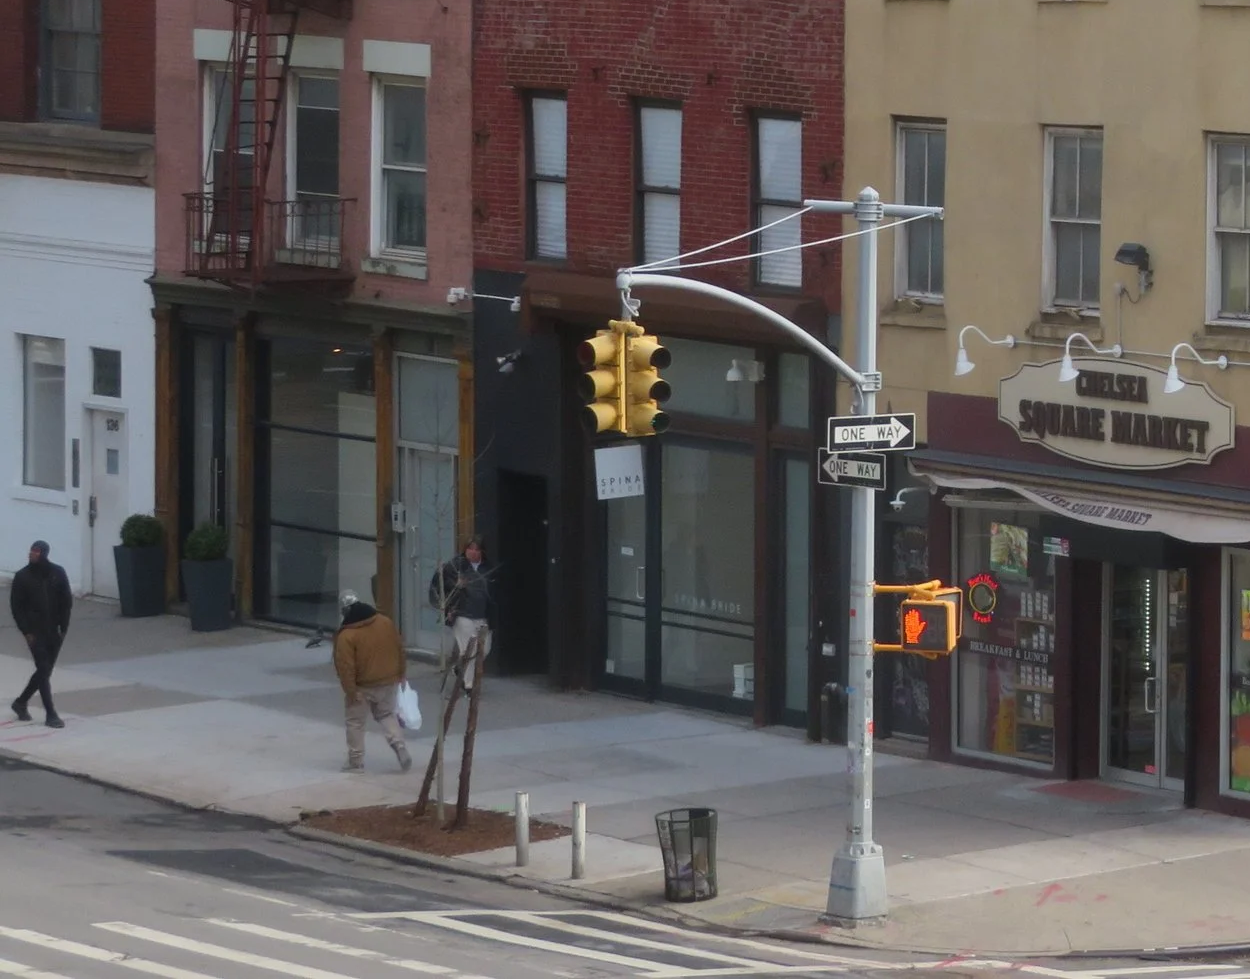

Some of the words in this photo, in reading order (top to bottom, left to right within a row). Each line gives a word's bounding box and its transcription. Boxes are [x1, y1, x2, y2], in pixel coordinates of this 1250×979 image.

[1075, 369, 1148, 404] CHELSEA
[842, 428, 865, 441] ONE
[877, 426, 902, 439] WAY
[1018, 399, 1105, 441] SQUARE
[1110, 410, 1209, 454] MARKET
[829, 461, 848, 474] ONE
[857, 463, 876, 477] WAY
[601, 475, 641, 487] SPINA
[1069, 502, 1108, 518] SQUARE
[1105, 507, 1152, 525] MARKET
[711, 599, 741, 614] BRIDE
[970, 641, 1013, 658] BREAKFAST
[1024, 651, 1049, 663] LUNCH
